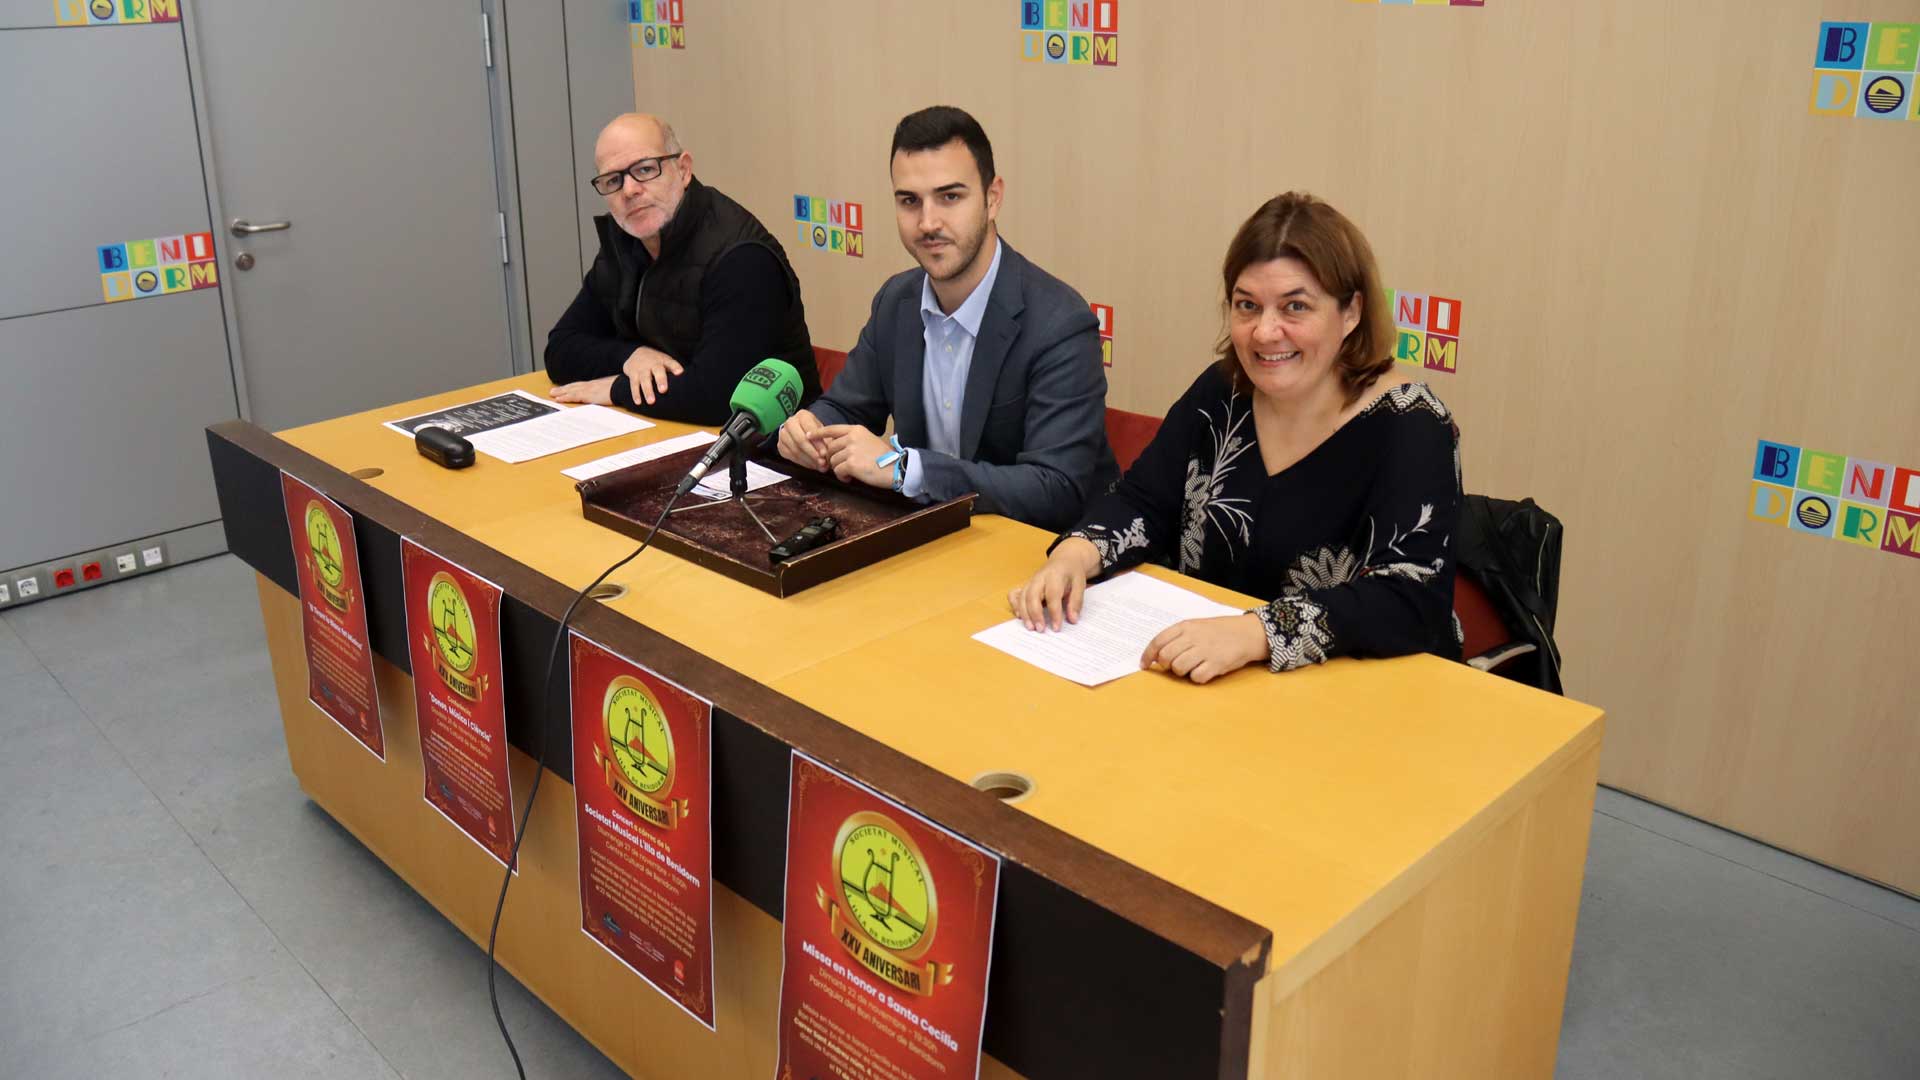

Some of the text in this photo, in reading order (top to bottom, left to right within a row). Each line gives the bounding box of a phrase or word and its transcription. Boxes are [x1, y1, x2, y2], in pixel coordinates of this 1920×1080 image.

[1024, 2, 1111, 28] BENI
[1023, 34, 1117, 62] DORM
[1823, 27, 1911, 64] BE
[1816, 75, 1920, 115] DO
[797, 198, 857, 227] BENI
[102, 236, 206, 269] BENI
[798, 224, 863, 254] DORM
[107, 261, 218, 297] DORM
[1399, 295, 1452, 330] NI
[1397, 332, 1457, 369] RM
[1760, 445, 1920, 508] BENI
[614, 780, 669, 825] XXV ANIVERSARI
[584, 802, 610, 828] Societat
[612, 820, 638, 846] Musical
[656, 848, 664, 863] de
[665, 854, 700, 888] Benidorm
[841, 928, 921, 992] XXV ANIVERSARI
[802, 940, 832, 966] Missa
[834, 961, 846, 976] en
[848, 968, 877, 996] honor
[878, 991, 886, 1004] a
[887, 996, 919, 1026] Santa
